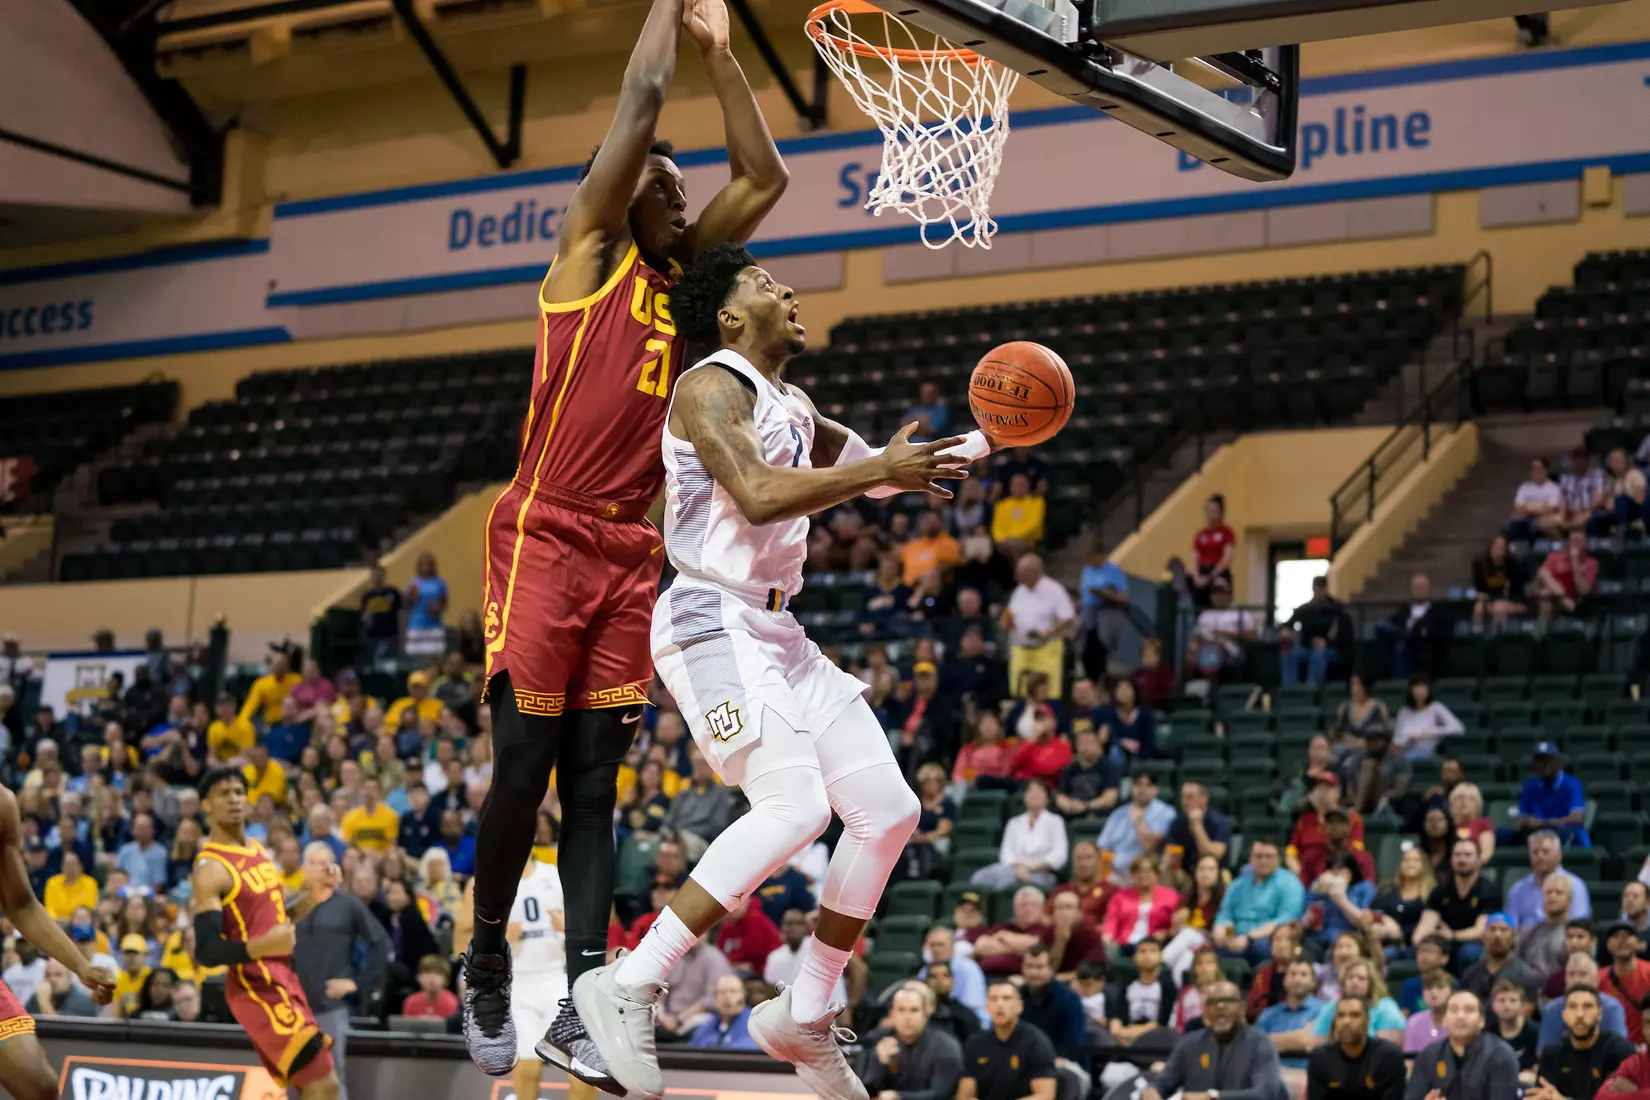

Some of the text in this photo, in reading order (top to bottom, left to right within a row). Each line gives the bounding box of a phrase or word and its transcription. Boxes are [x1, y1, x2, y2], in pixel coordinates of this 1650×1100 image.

[448, 200, 567, 250] Dedic
[630, 275, 677, 337] US
[636, 338, 672, 399] 21
[704, 700, 744, 743] MU
[241, 861, 281, 894] US
[523, 896, 540, 922] 0
